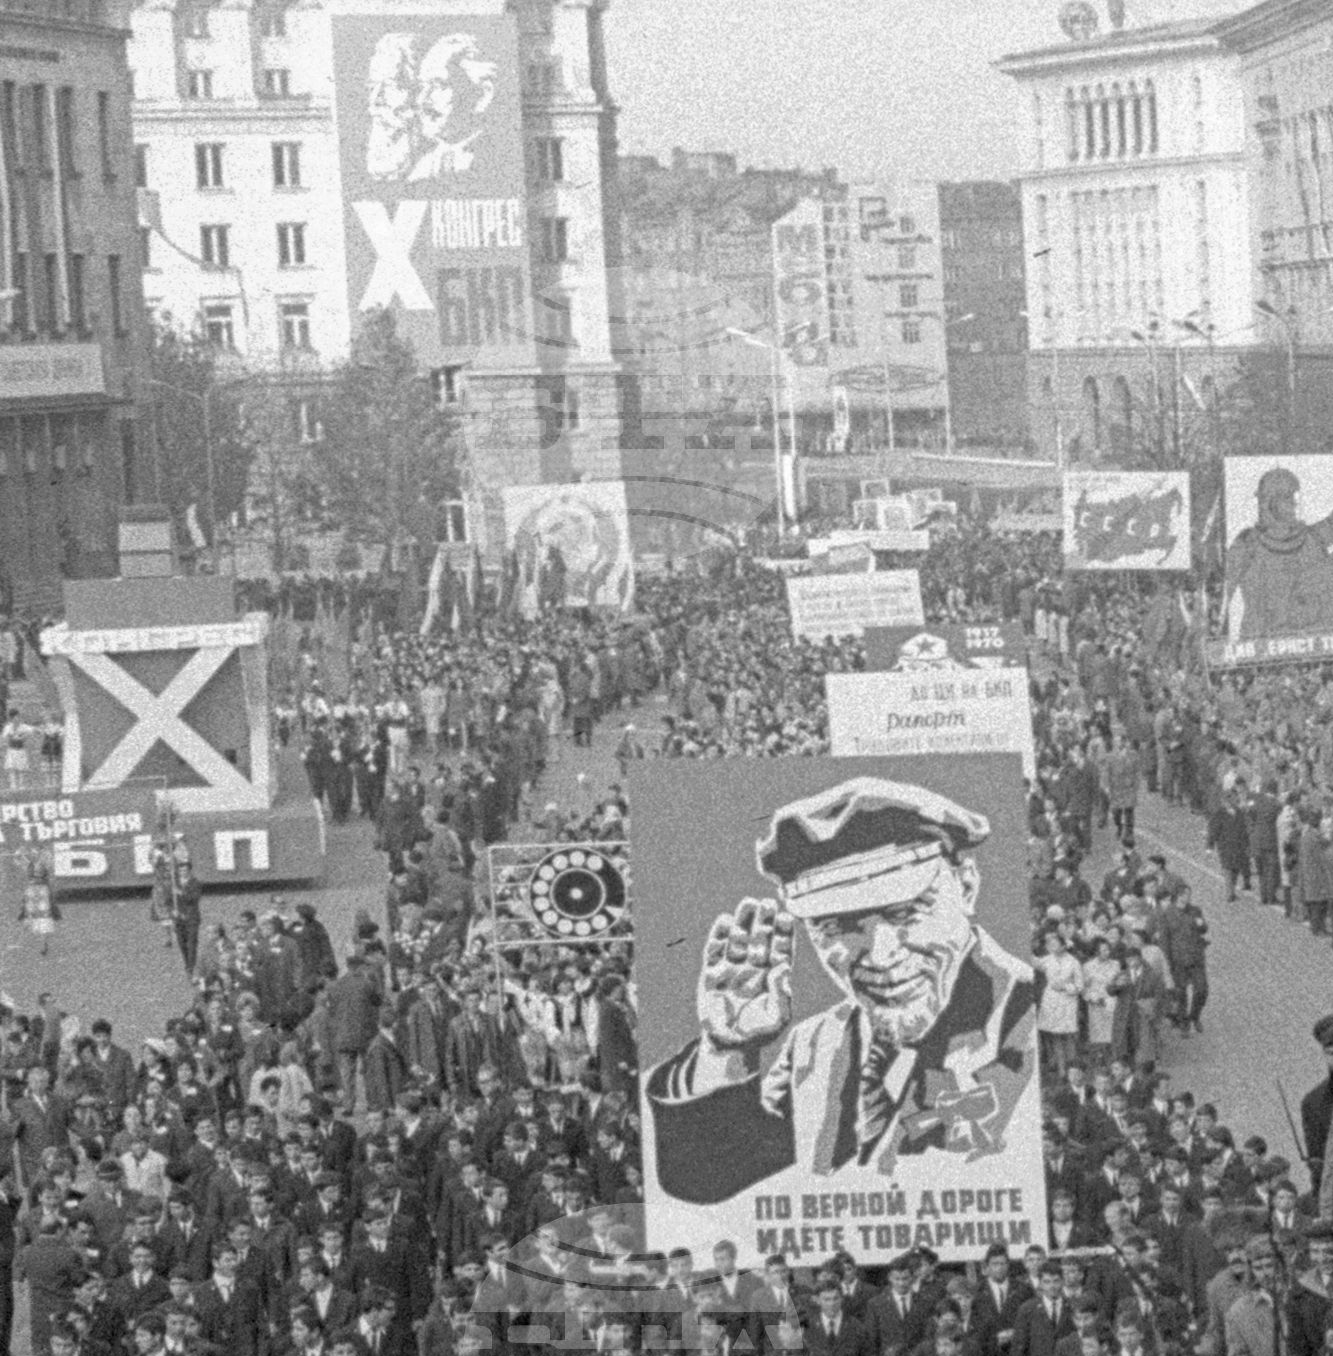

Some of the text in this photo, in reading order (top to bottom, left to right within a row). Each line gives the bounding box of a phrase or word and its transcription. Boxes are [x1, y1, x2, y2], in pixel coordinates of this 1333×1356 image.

[20, 812, 143, 841] ТЪРГОВИЯ
[754, 1182, 1023, 1221] ПО ВЕРНОЙ ДОРОГЕ
[756, 1220, 1031, 1259] ИДЕТЕ ТОВАРИЩИ
